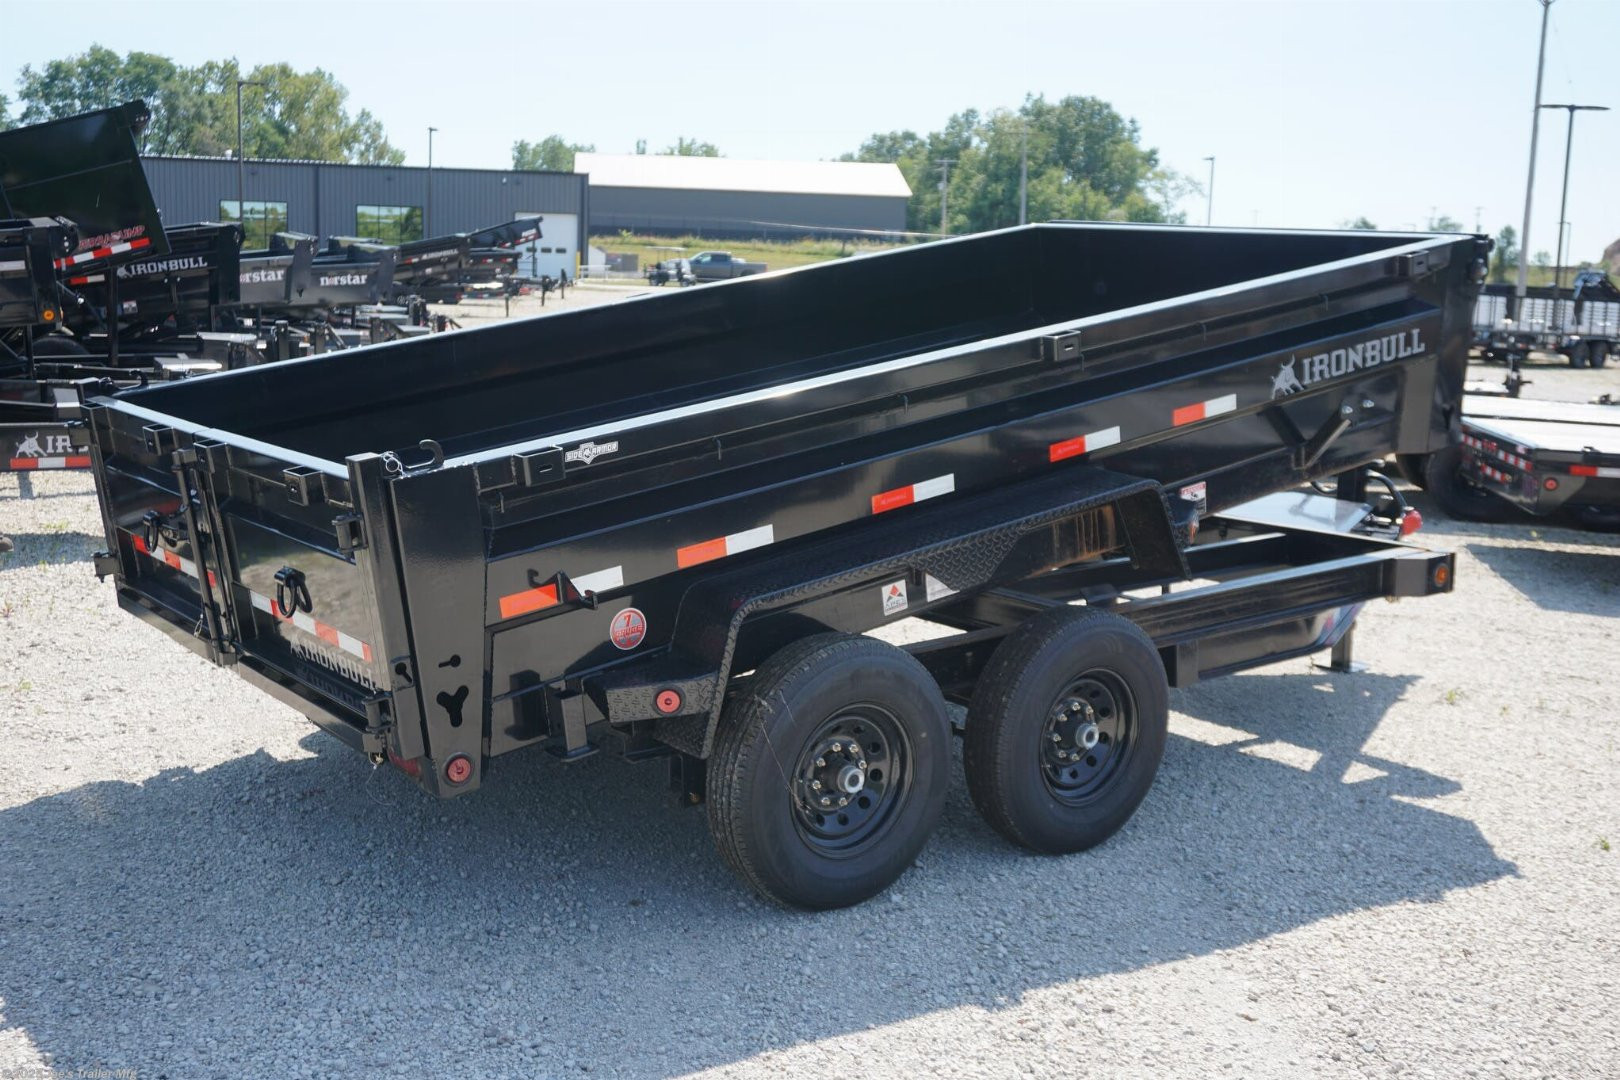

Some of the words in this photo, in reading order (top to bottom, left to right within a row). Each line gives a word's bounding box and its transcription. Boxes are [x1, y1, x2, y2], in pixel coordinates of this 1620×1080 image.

[130, 256, 208, 276] IRONBULL
[320, 273, 368, 287] norstar
[1302, 328, 1426, 386] IRONBULL
[623, 612, 632, 628] 7
[303, 640, 377, 695] IRONBULL
